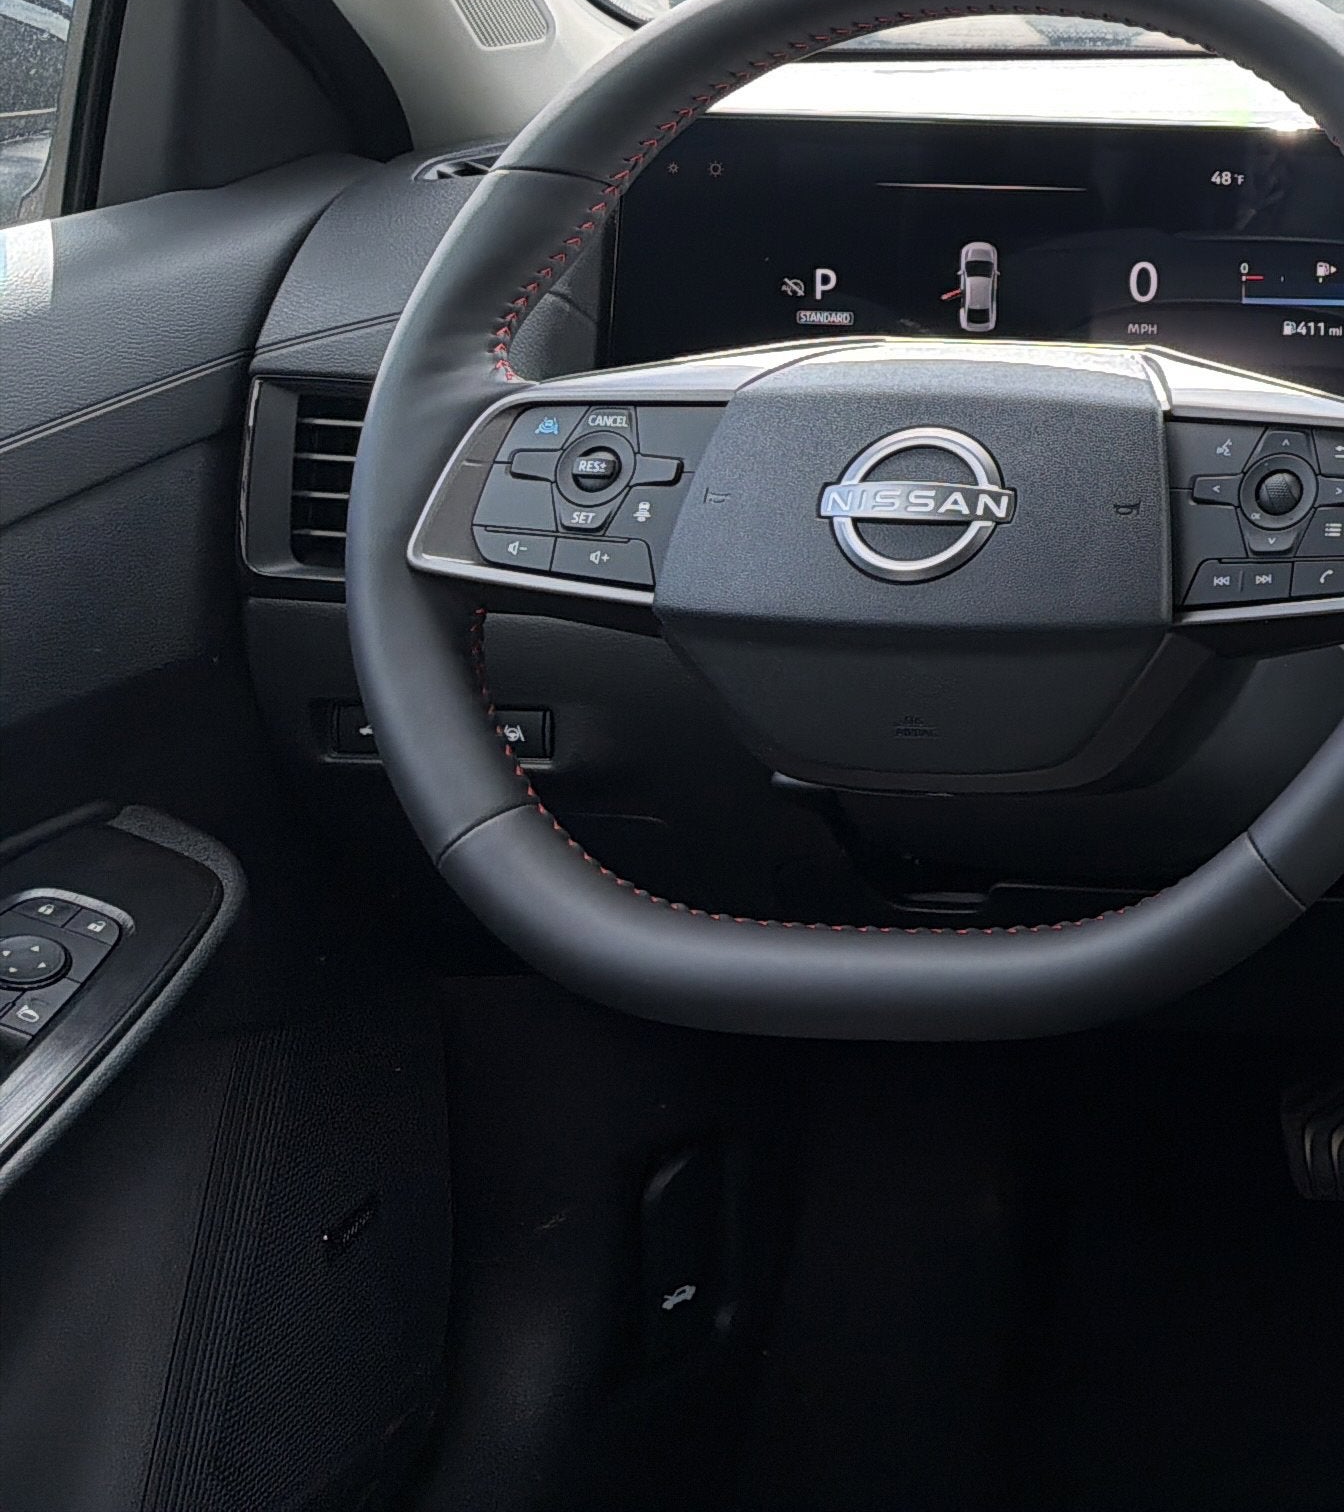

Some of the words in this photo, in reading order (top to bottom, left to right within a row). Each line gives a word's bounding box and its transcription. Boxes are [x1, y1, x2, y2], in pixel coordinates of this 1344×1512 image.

[1211, 171, 1231, 185] 48
[1240, 263, 1249, 273] 0
[815, 268, 837, 300] P
[1129, 261, 1158, 303] 0
[800, 312, 850, 324] STANDARD
[1127, 323, 1158, 335] MPH
[1296, 322, 1325, 336] 411
[1328, 325, 1343, 336] mi
[588, 415, 628, 427] CANCEL
[827, 489, 1009, 517] NISSAN
[571, 511, 596, 524] SET
